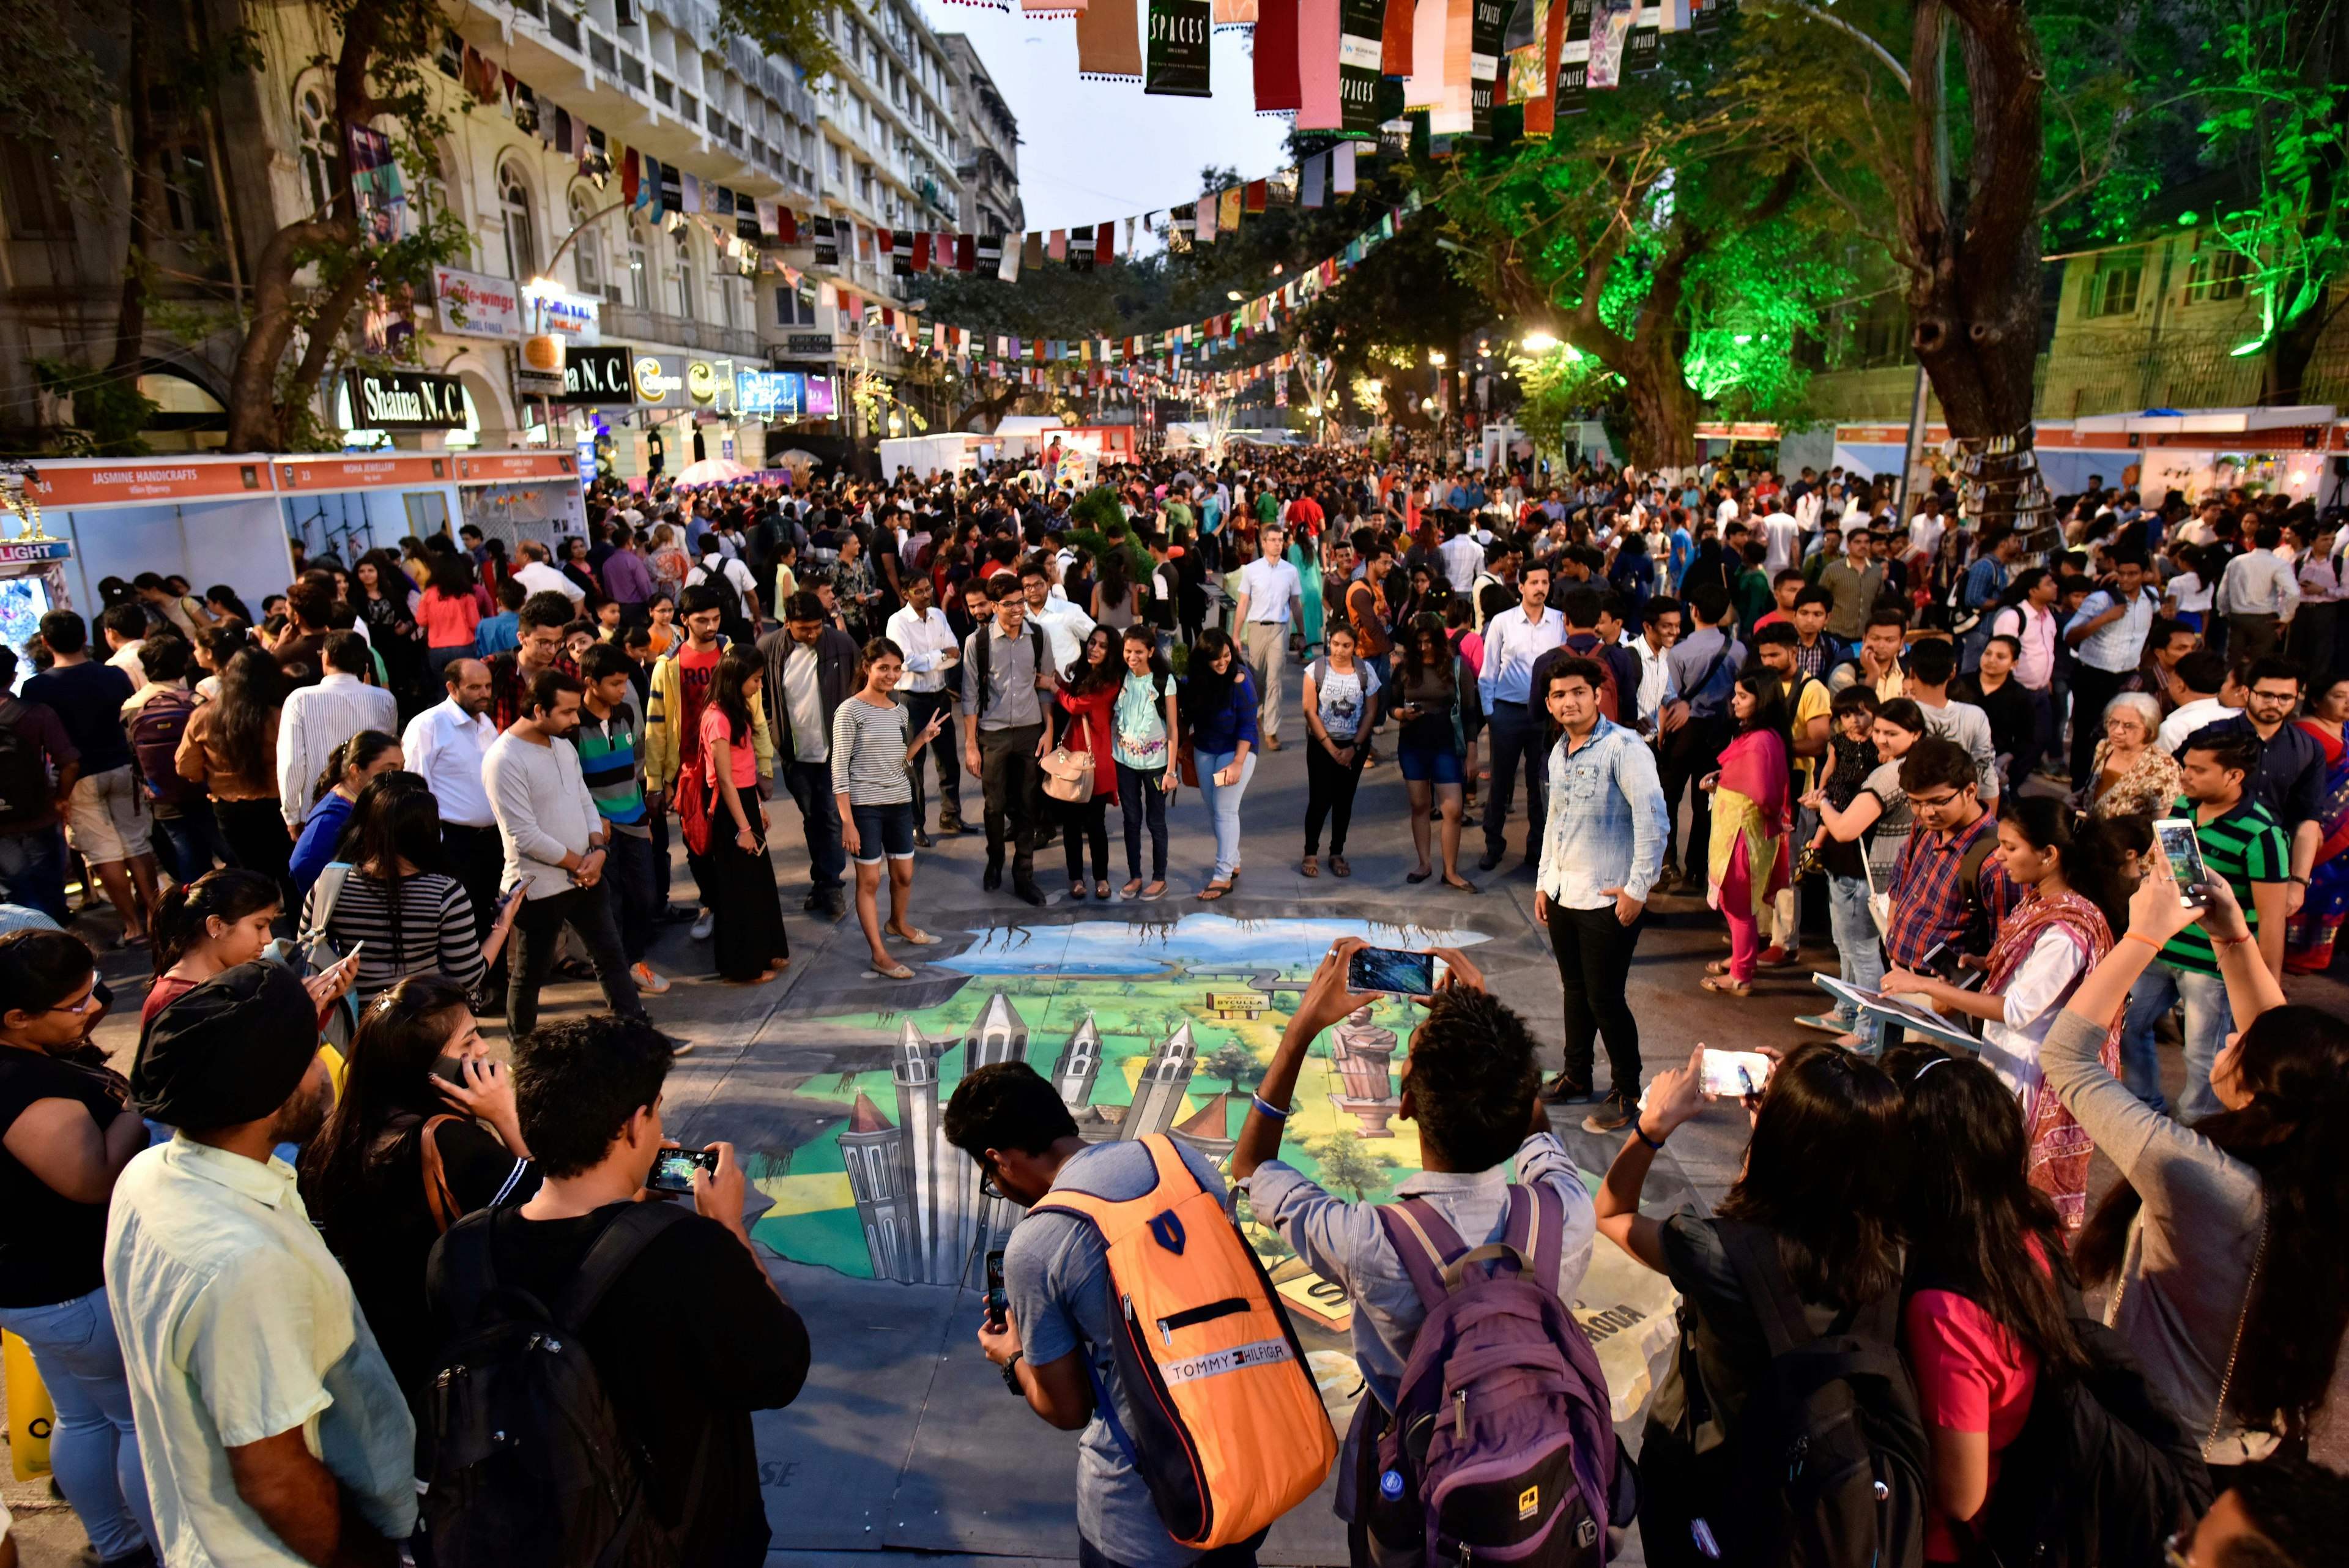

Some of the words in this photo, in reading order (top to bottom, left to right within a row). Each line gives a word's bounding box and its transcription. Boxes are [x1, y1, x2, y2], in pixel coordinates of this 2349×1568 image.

[1152, 13, 1203, 45] SPACES
[581, 358, 604, 392] N.
[606, 357, 629, 393] C.
[363, 376, 423, 422] Shaina
[420, 381, 444, 421] N.
[444, 382, 464, 422] C.
[92, 471, 135, 485] JASMINE
[136, 469, 198, 482] HANDICRAFTS
[1173, 1355, 1229, 1380] TOMMY
[1243, 1345, 1284, 1363] HILFIGER
